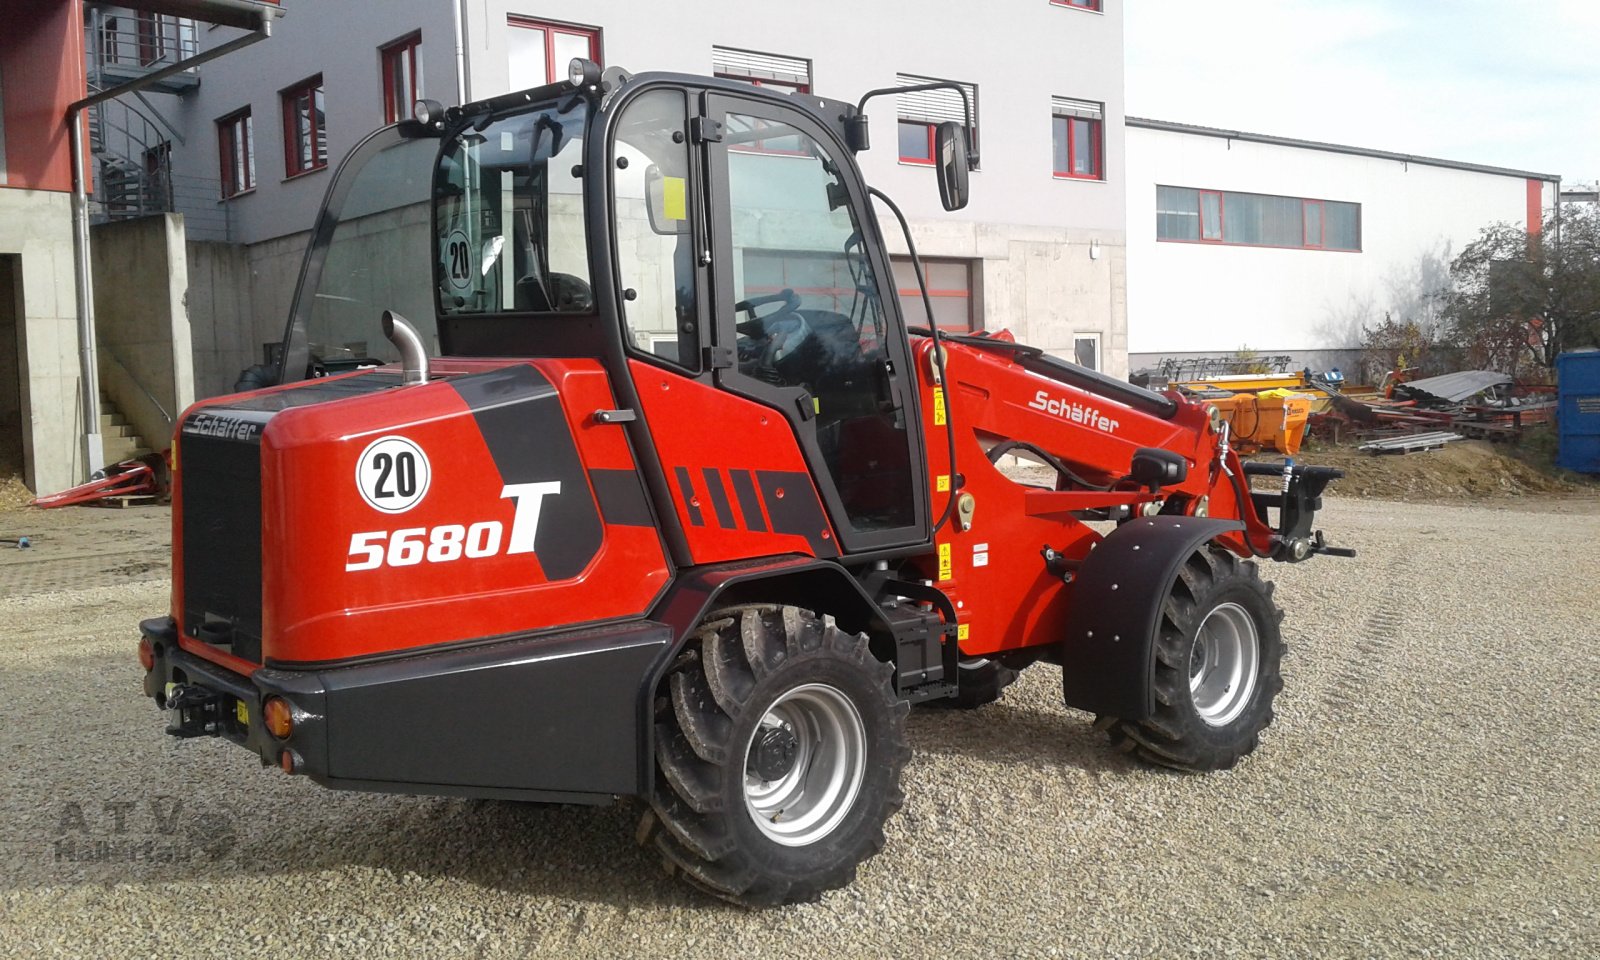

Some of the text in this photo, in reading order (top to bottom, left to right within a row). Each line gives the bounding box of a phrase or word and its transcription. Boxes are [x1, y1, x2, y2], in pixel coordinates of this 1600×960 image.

[450, 241, 470, 279] 20
[183, 415, 257, 441] Schäffer
[1028, 390, 1120, 433] Schäffer
[372, 451, 417, 499] 20
